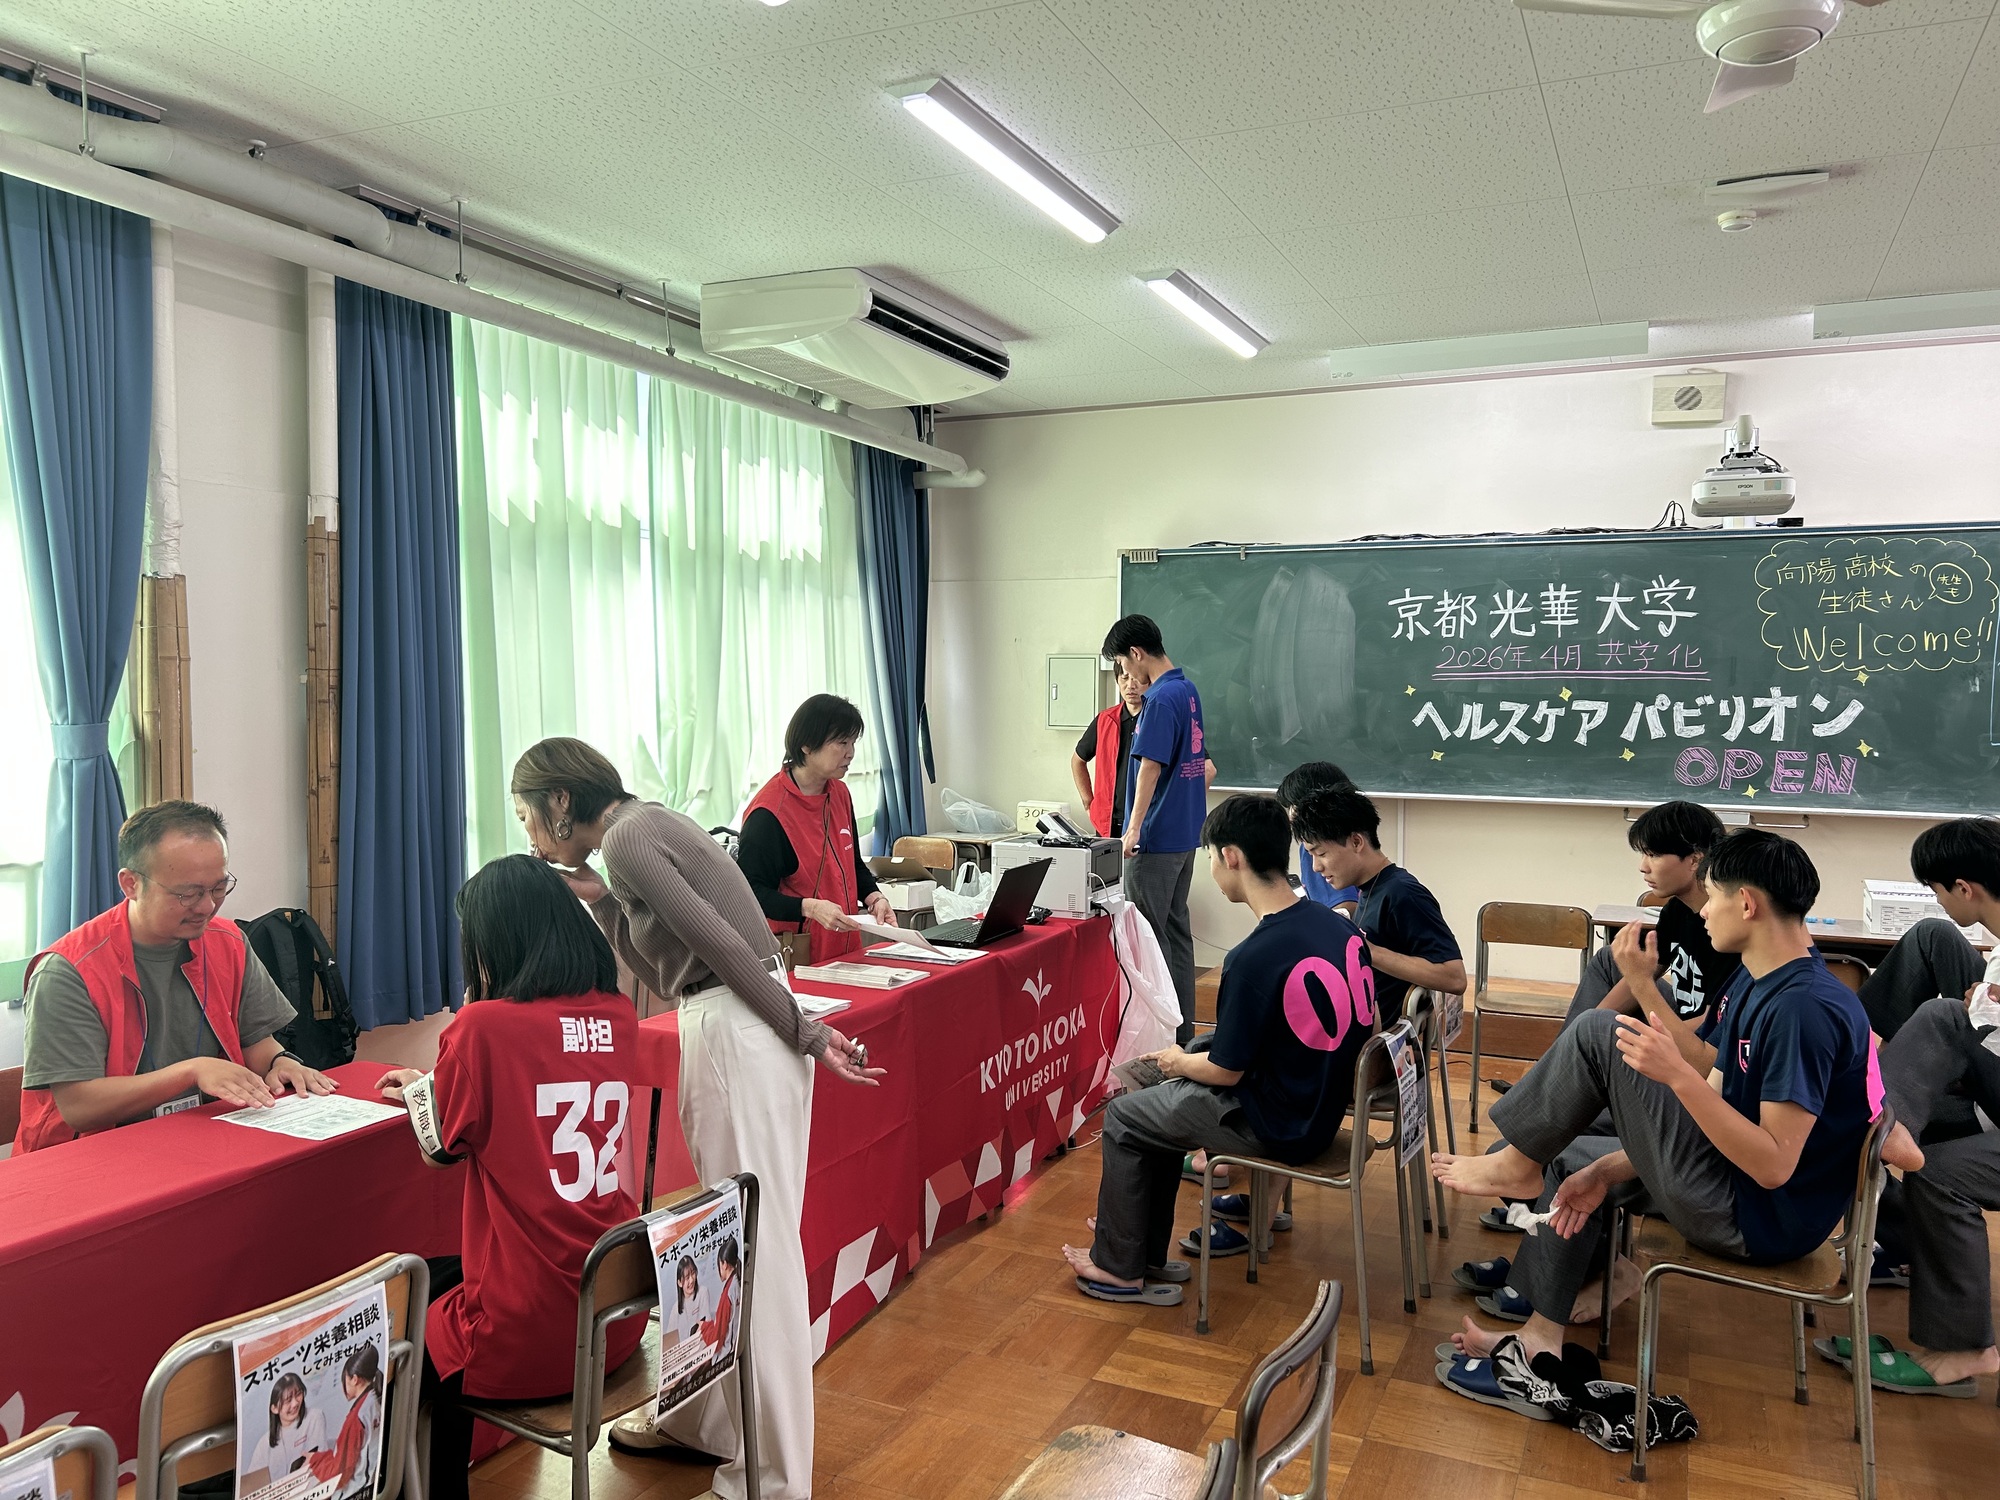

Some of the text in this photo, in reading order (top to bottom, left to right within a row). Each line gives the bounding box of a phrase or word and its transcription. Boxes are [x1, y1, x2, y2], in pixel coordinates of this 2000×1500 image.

[1776, 552, 1927, 585] 向陽高校の
[1936, 574, 1963, 586] 先生
[1817, 586, 1924, 615] 生徒さん
[1793, 616, 1993, 662] Welcome!!
[1674, 746, 1858, 795] OPEN
[1283, 935, 1375, 1052] 06
[559, 1016, 614, 1053] 副担
[979, 1003, 1087, 1094] KYOTO KOKA
[1005, 1054, 1070, 1112] UNIVERSITY
[412, 1087, 438, 1153] 教職
[536, 1080, 629, 1203] 32
[659, 1205, 738, 1269] スポーツ栄養相談
[243, 1302, 381, 1393] スポーツ栄養相談
[302, 1332, 382, 1376] してみませんか？
